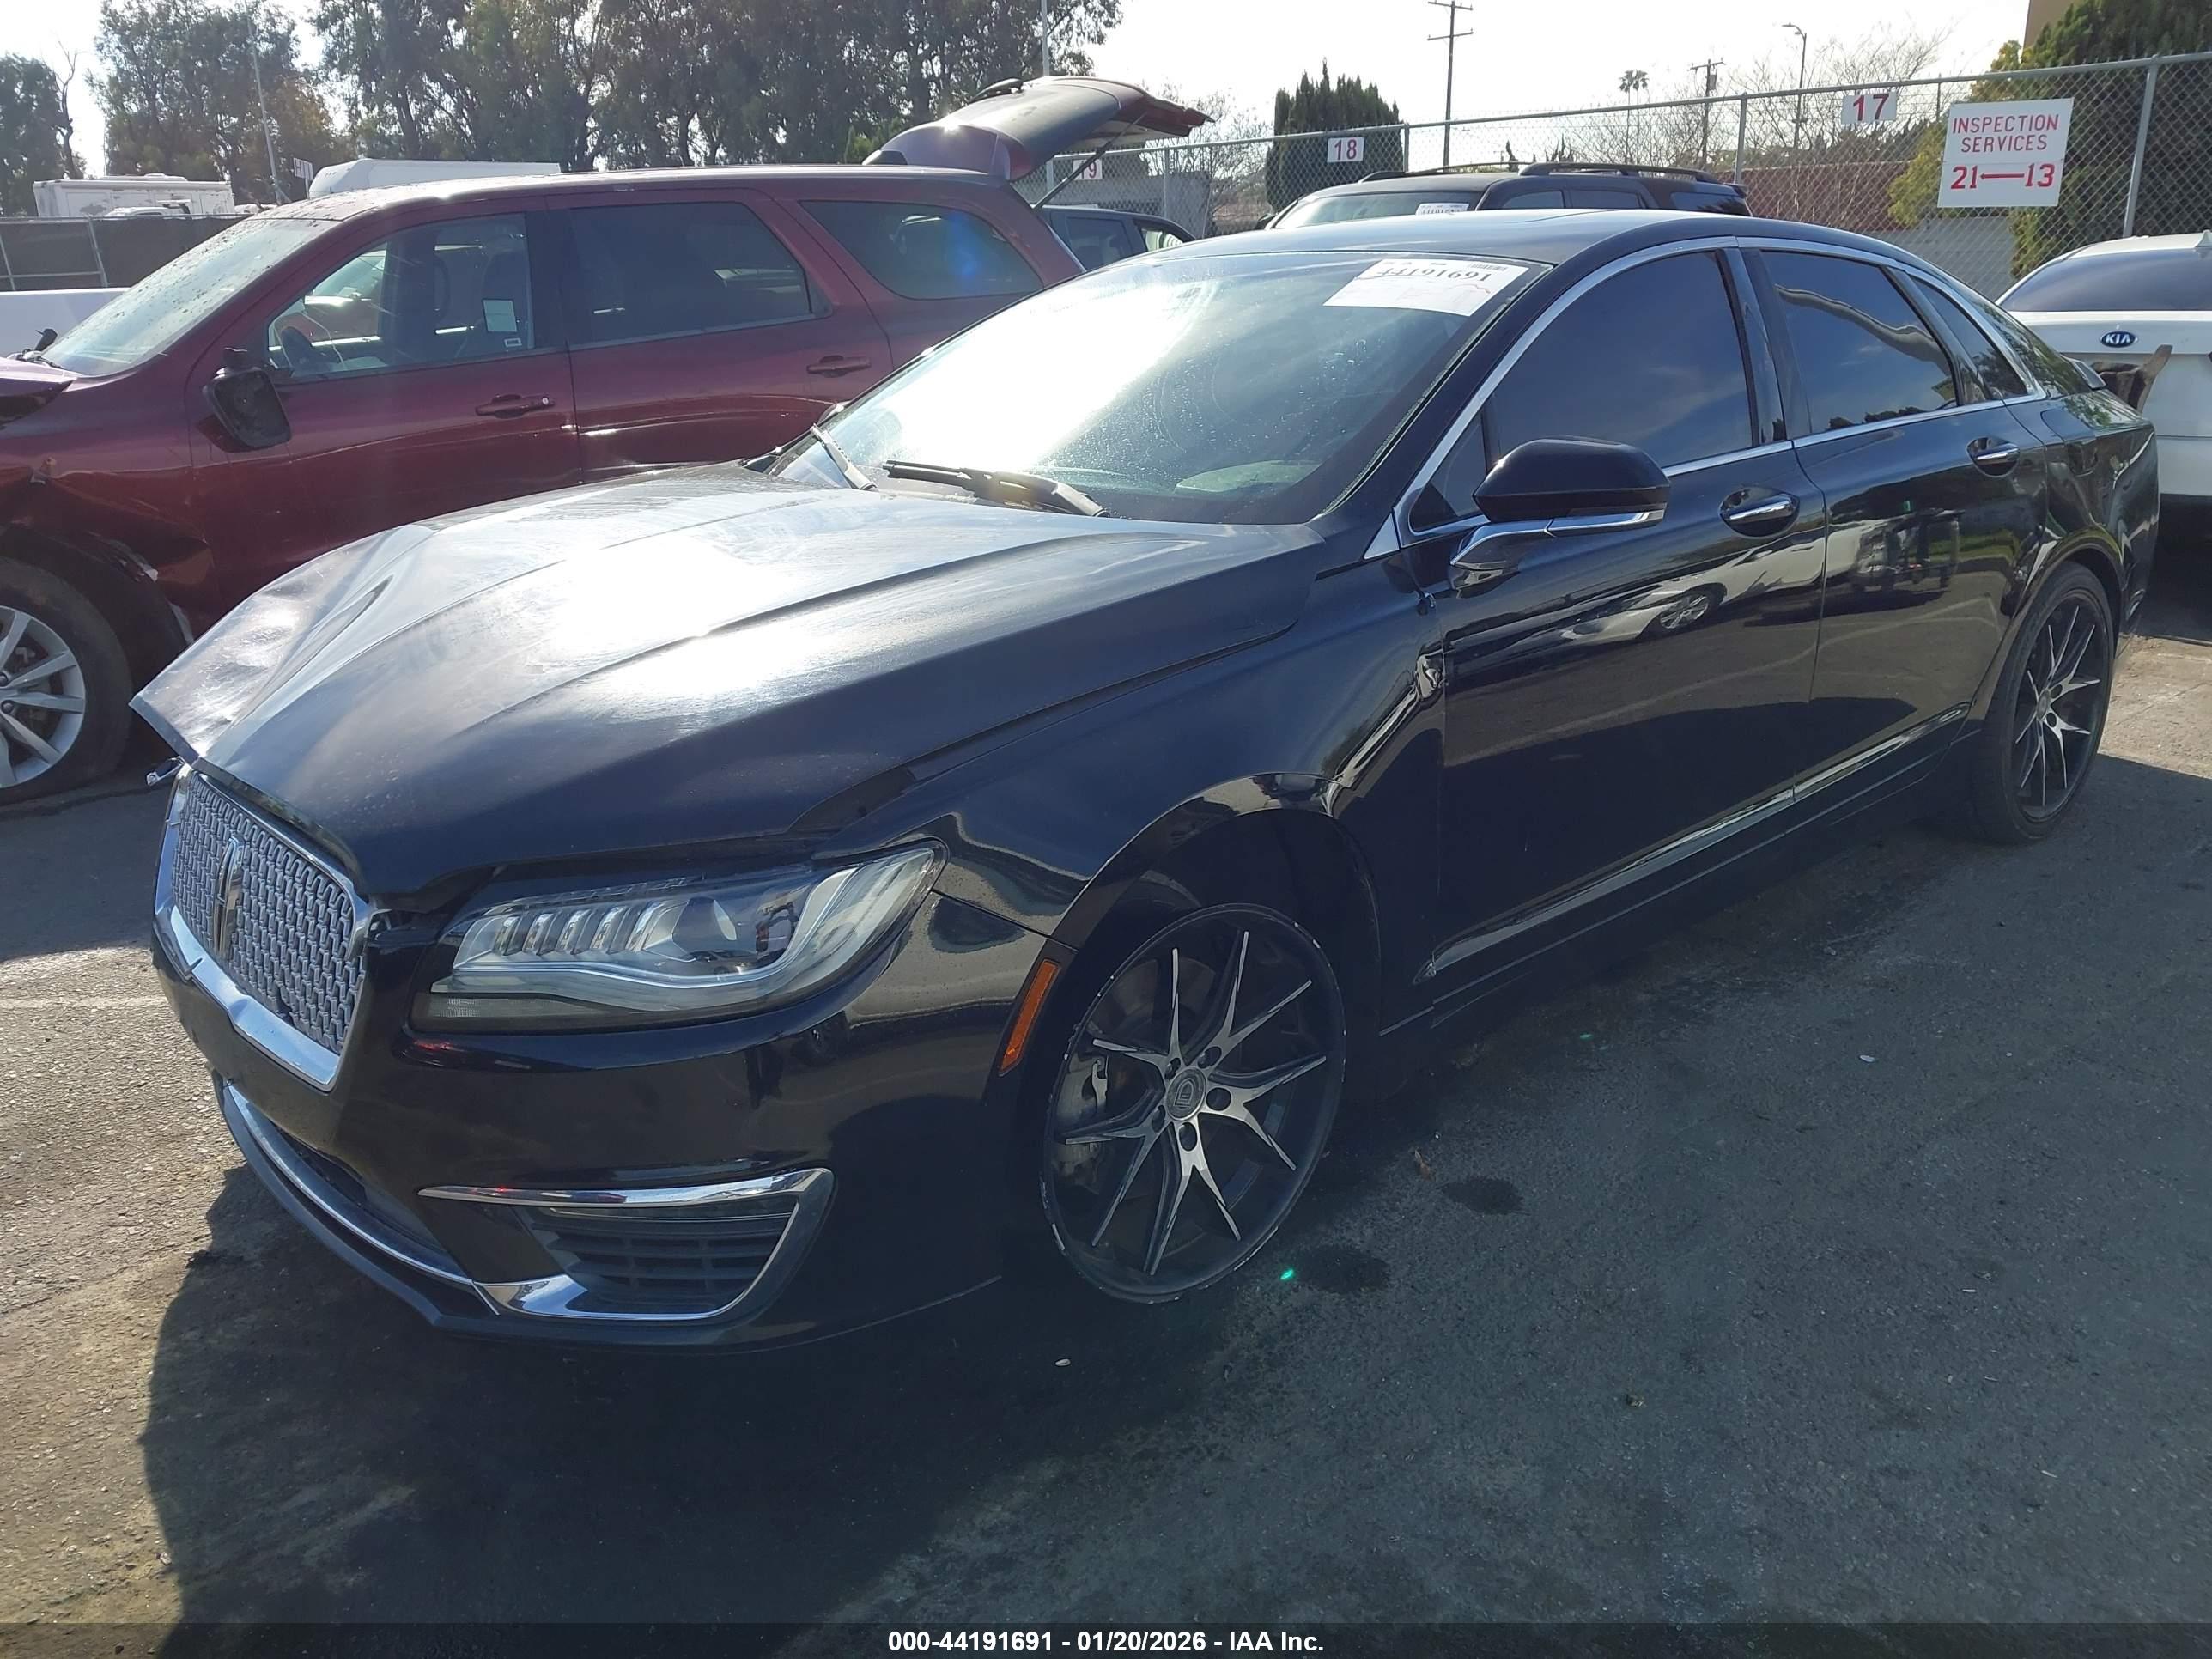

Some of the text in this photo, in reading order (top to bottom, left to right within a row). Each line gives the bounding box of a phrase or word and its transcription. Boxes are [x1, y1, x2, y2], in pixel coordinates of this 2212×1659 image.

[1853, 94, 1889, 121] 17
[1952, 114, 2059, 134] INSPECTION
[1334, 139, 1357, 161] 18
[1960, 134, 2048, 153] SERVICES
[1950, 163, 2056, 190] 21 13
[2106, 334, 2130, 344] KIA
